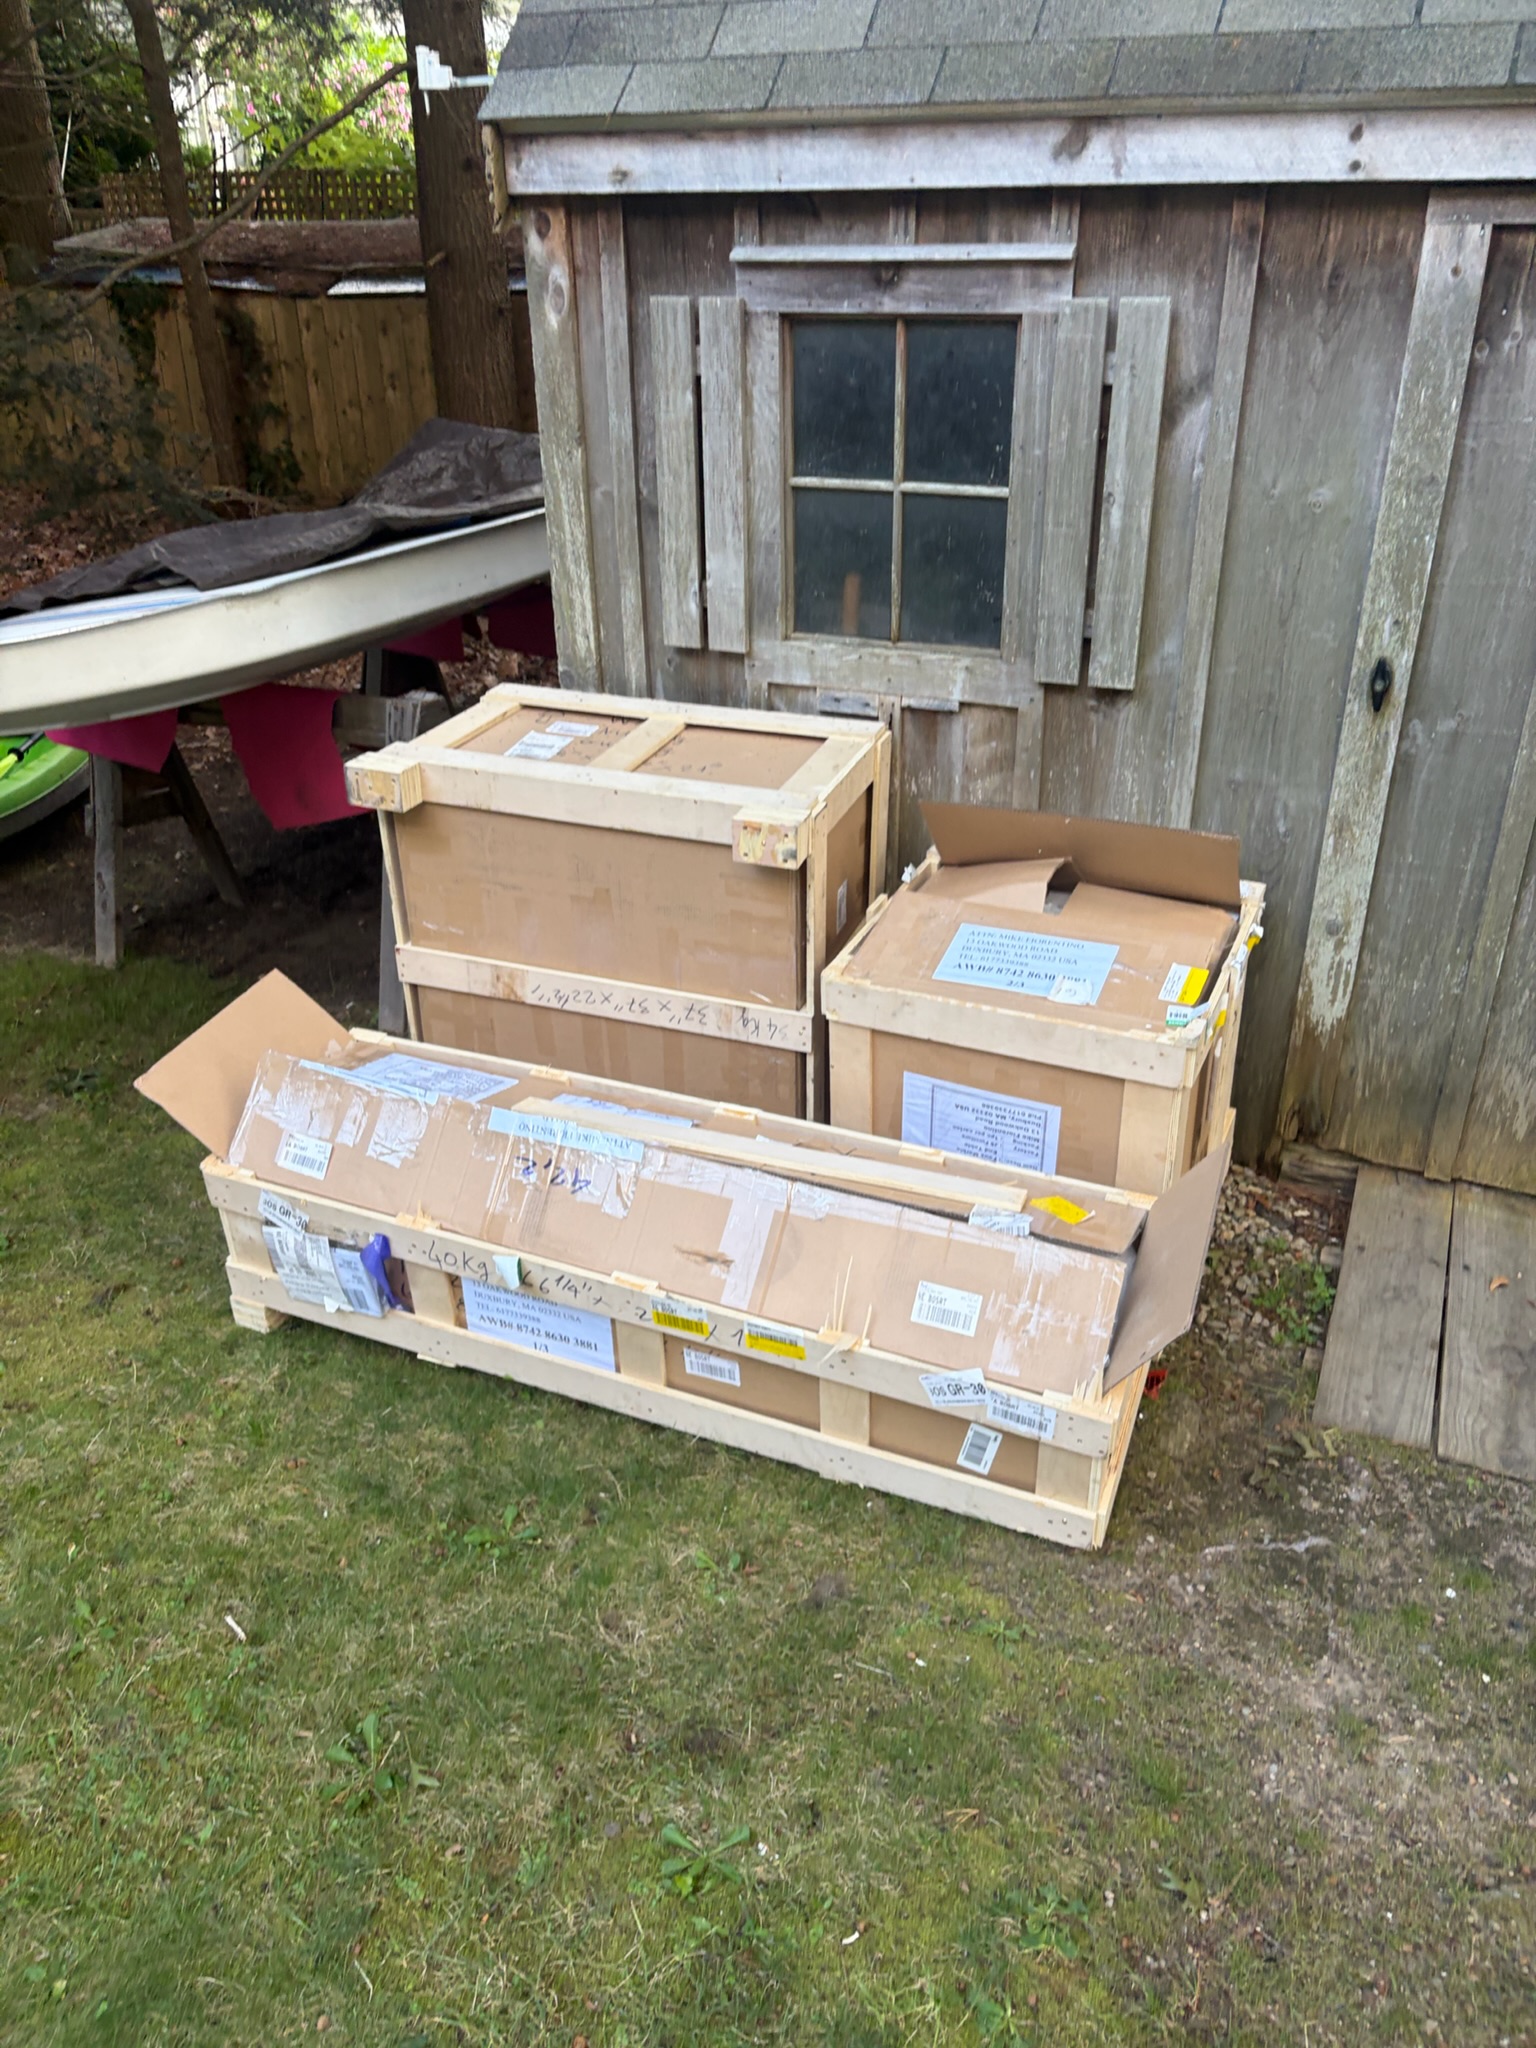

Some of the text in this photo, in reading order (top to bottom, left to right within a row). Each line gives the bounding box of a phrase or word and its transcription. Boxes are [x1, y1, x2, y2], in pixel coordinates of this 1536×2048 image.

[998, 933, 1023, 942] MIKE
[977, 939, 1029, 951] OAKWOOD
[1030, 945, 1058, 954] ROAD
[1013, 951, 1029, 959] MA
[1059, 957, 1078, 966] USA
[953, 962, 993, 973] AWB#
[995, 966, 1025, 978] 8742
[954, 1103, 970, 1112] USA
[975, 1115, 993, 1125] Road
[995, 1120, 1030, 1133] Oakwood
[983, 1125, 1040, 1143] Mike Fiorentino
[1013, 1145, 1039, 1157] Factory
[522, 1302, 537, 1313] MA
[562, 1312, 582, 1323] USA
[479, 1313, 598, 1352] AWB# 8742 8630 3881
[533, 1341, 549, 1353] 1/3
